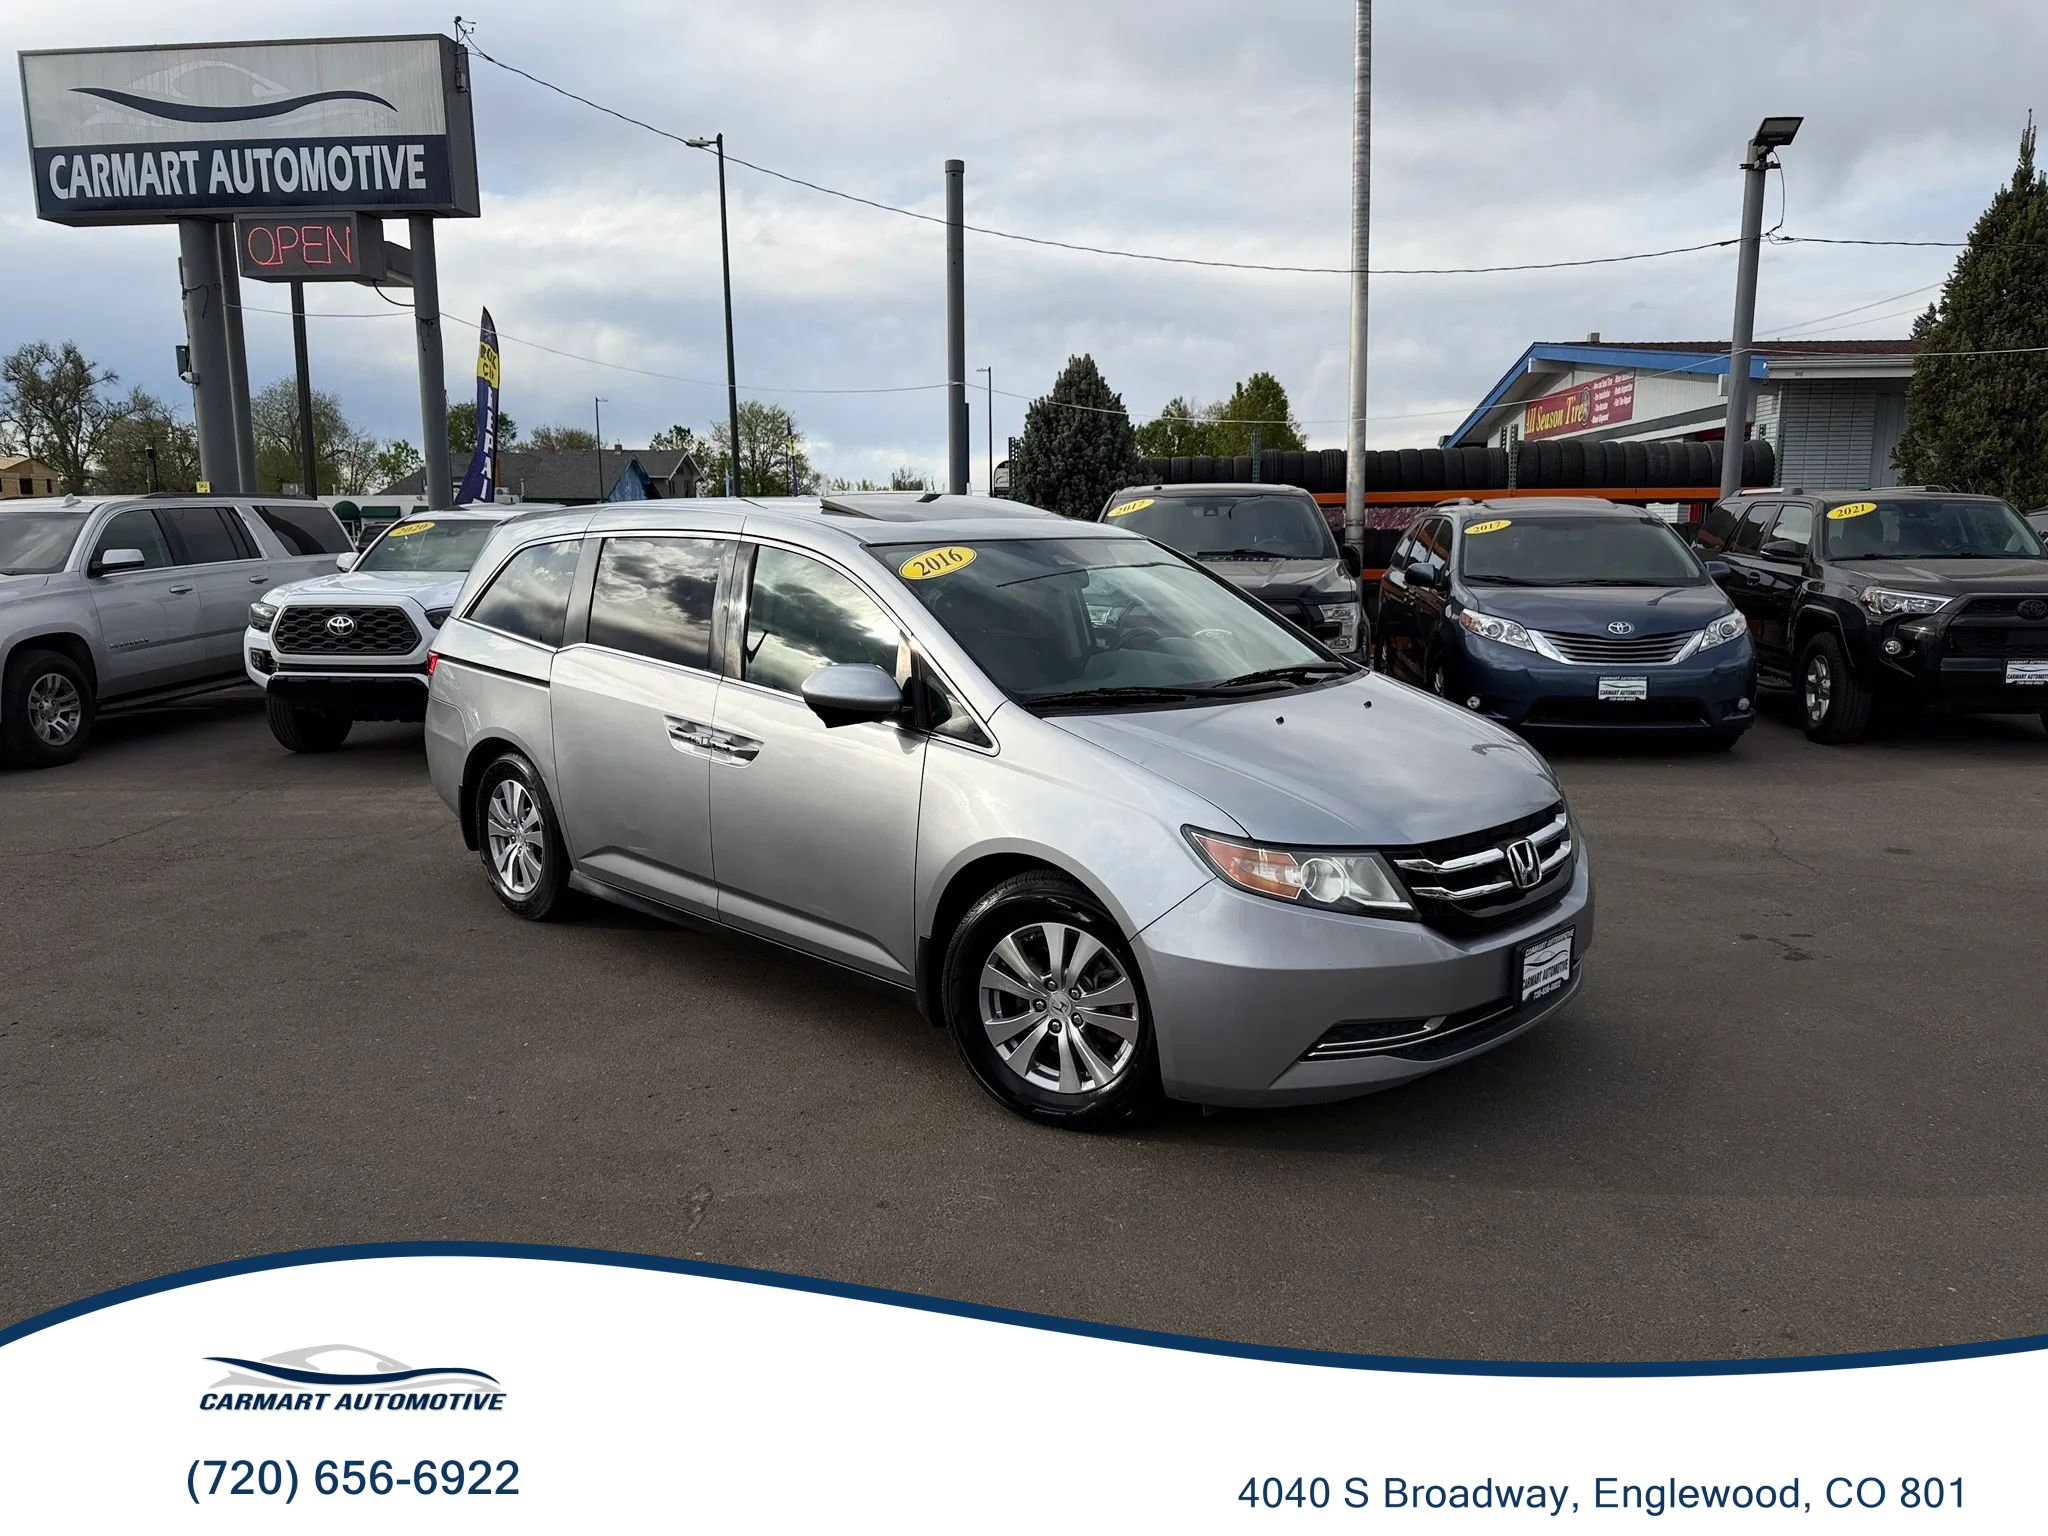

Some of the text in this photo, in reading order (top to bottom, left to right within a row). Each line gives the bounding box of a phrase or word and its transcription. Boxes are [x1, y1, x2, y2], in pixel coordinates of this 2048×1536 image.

[49, 143, 427, 200] CARMART AUTOMOTIVE
[247, 225, 353, 266] OPEN
[1526, 408, 1537, 433] All
[1536, 406, 1564, 431] Season
[1837, 504, 1866, 517] 2021
[1473, 521, 1502, 533] 2017
[913, 548, 963, 576] 2016
[1525, 939, 1549, 958] CARMART
[1542, 958, 1569, 981] AUTOMOTIVE
